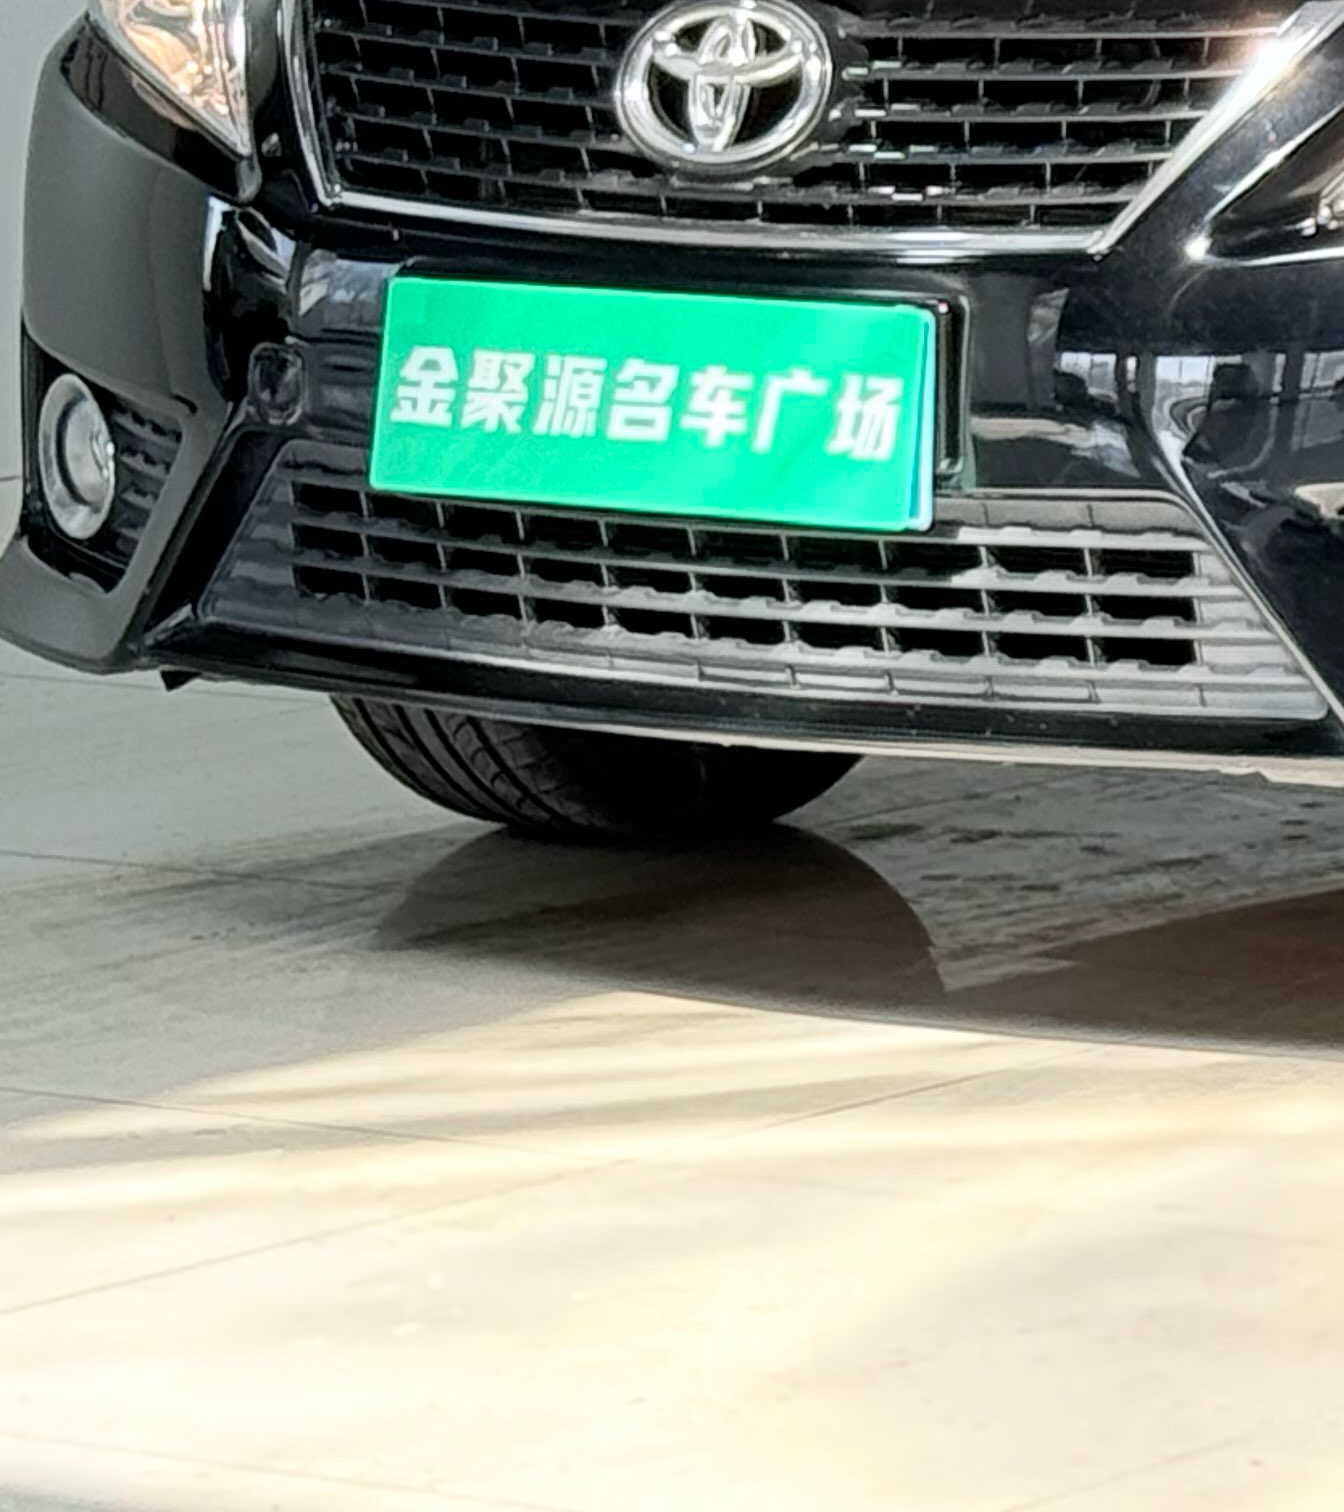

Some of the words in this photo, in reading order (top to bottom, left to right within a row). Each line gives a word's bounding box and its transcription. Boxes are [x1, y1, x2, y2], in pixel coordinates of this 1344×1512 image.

[390, 343, 905, 462] 金聚源名车广场
